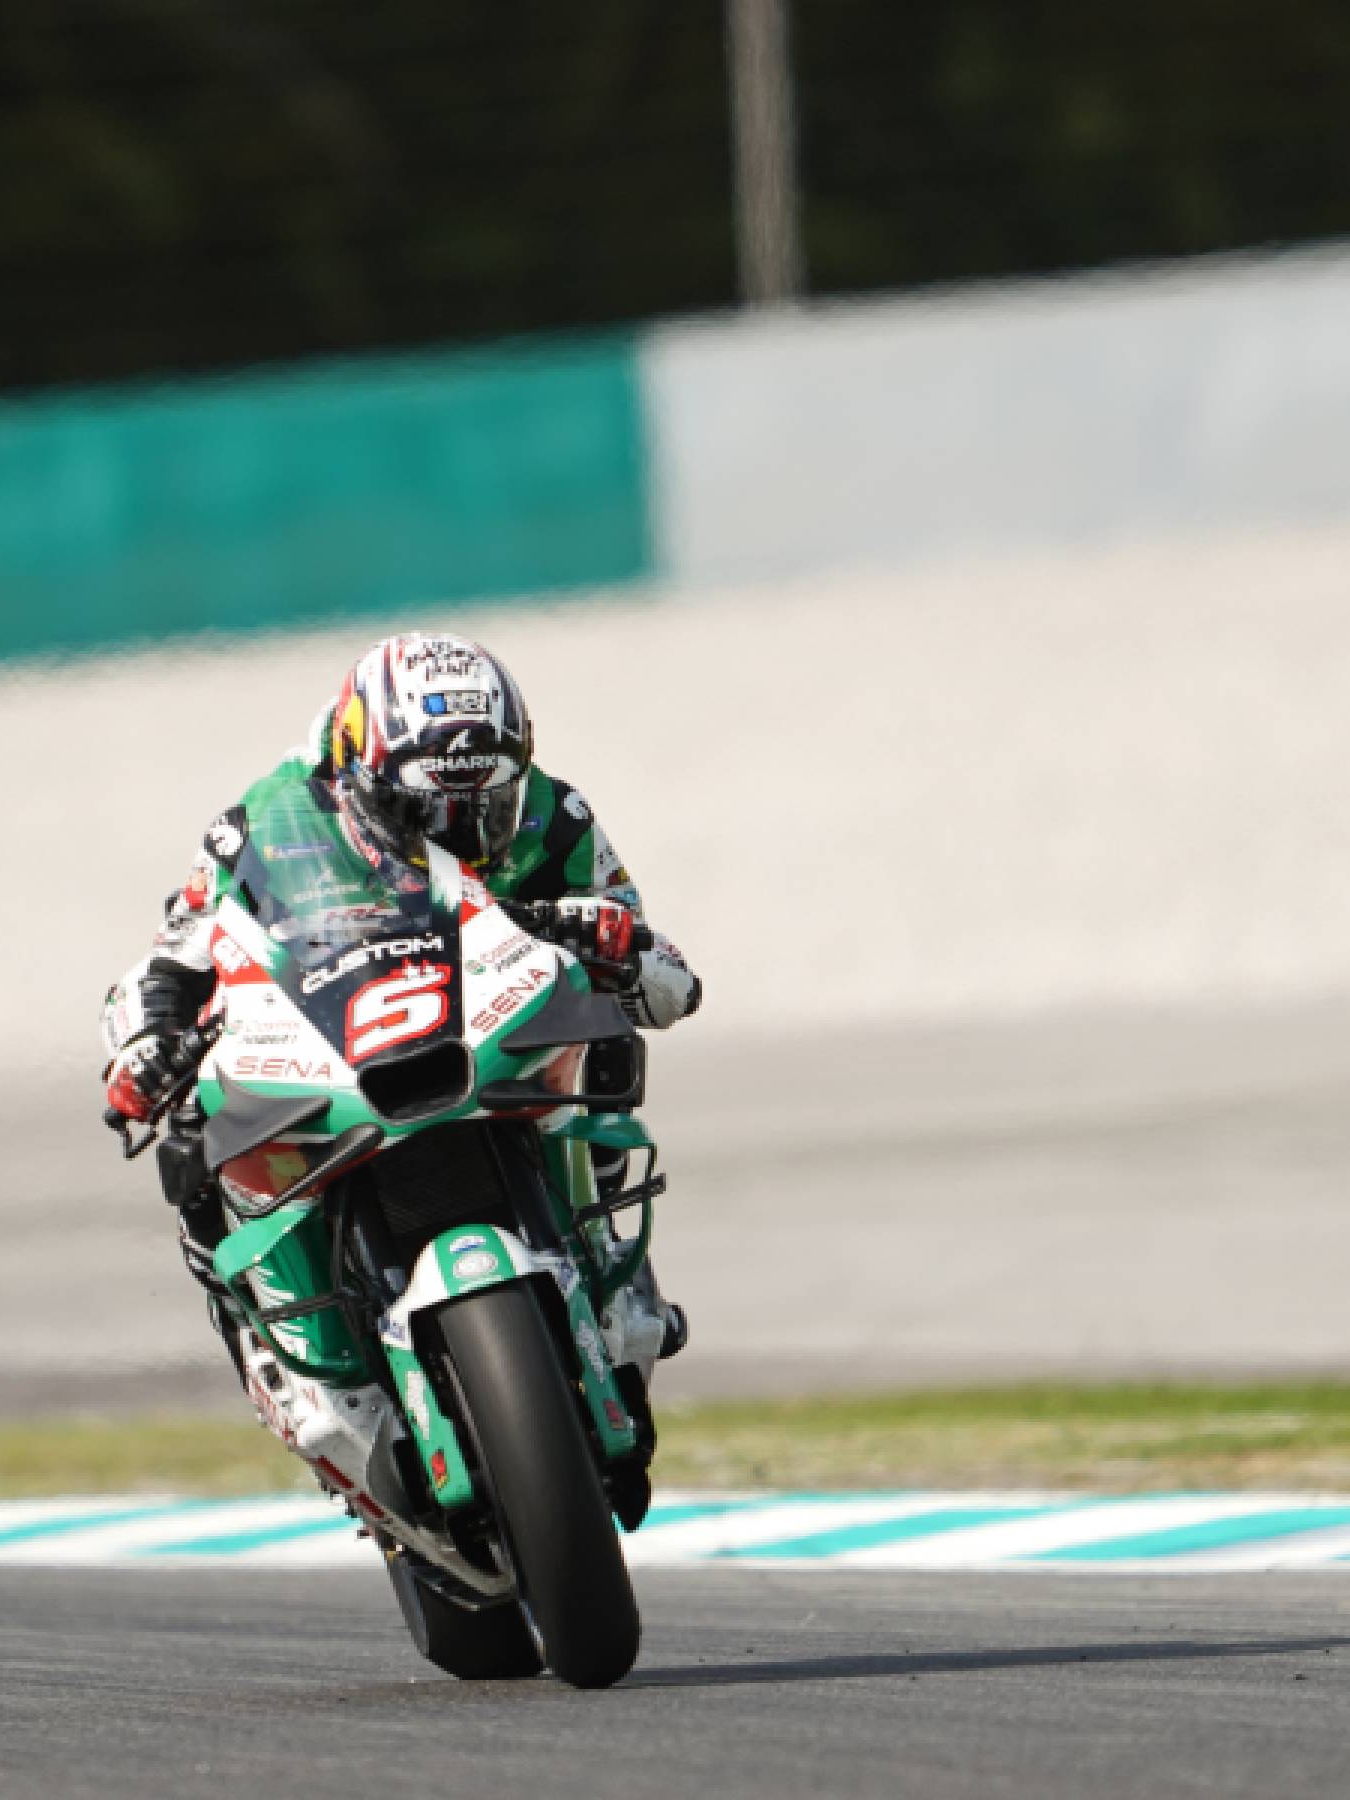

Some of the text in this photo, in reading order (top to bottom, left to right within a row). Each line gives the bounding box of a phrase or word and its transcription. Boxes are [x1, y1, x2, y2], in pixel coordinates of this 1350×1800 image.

[421, 754, 498, 772] SHARK
[301, 936, 444, 994] CUSTOM
[470, 969, 550, 1033] SENA
[234, 1055, 333, 1080] SENA
